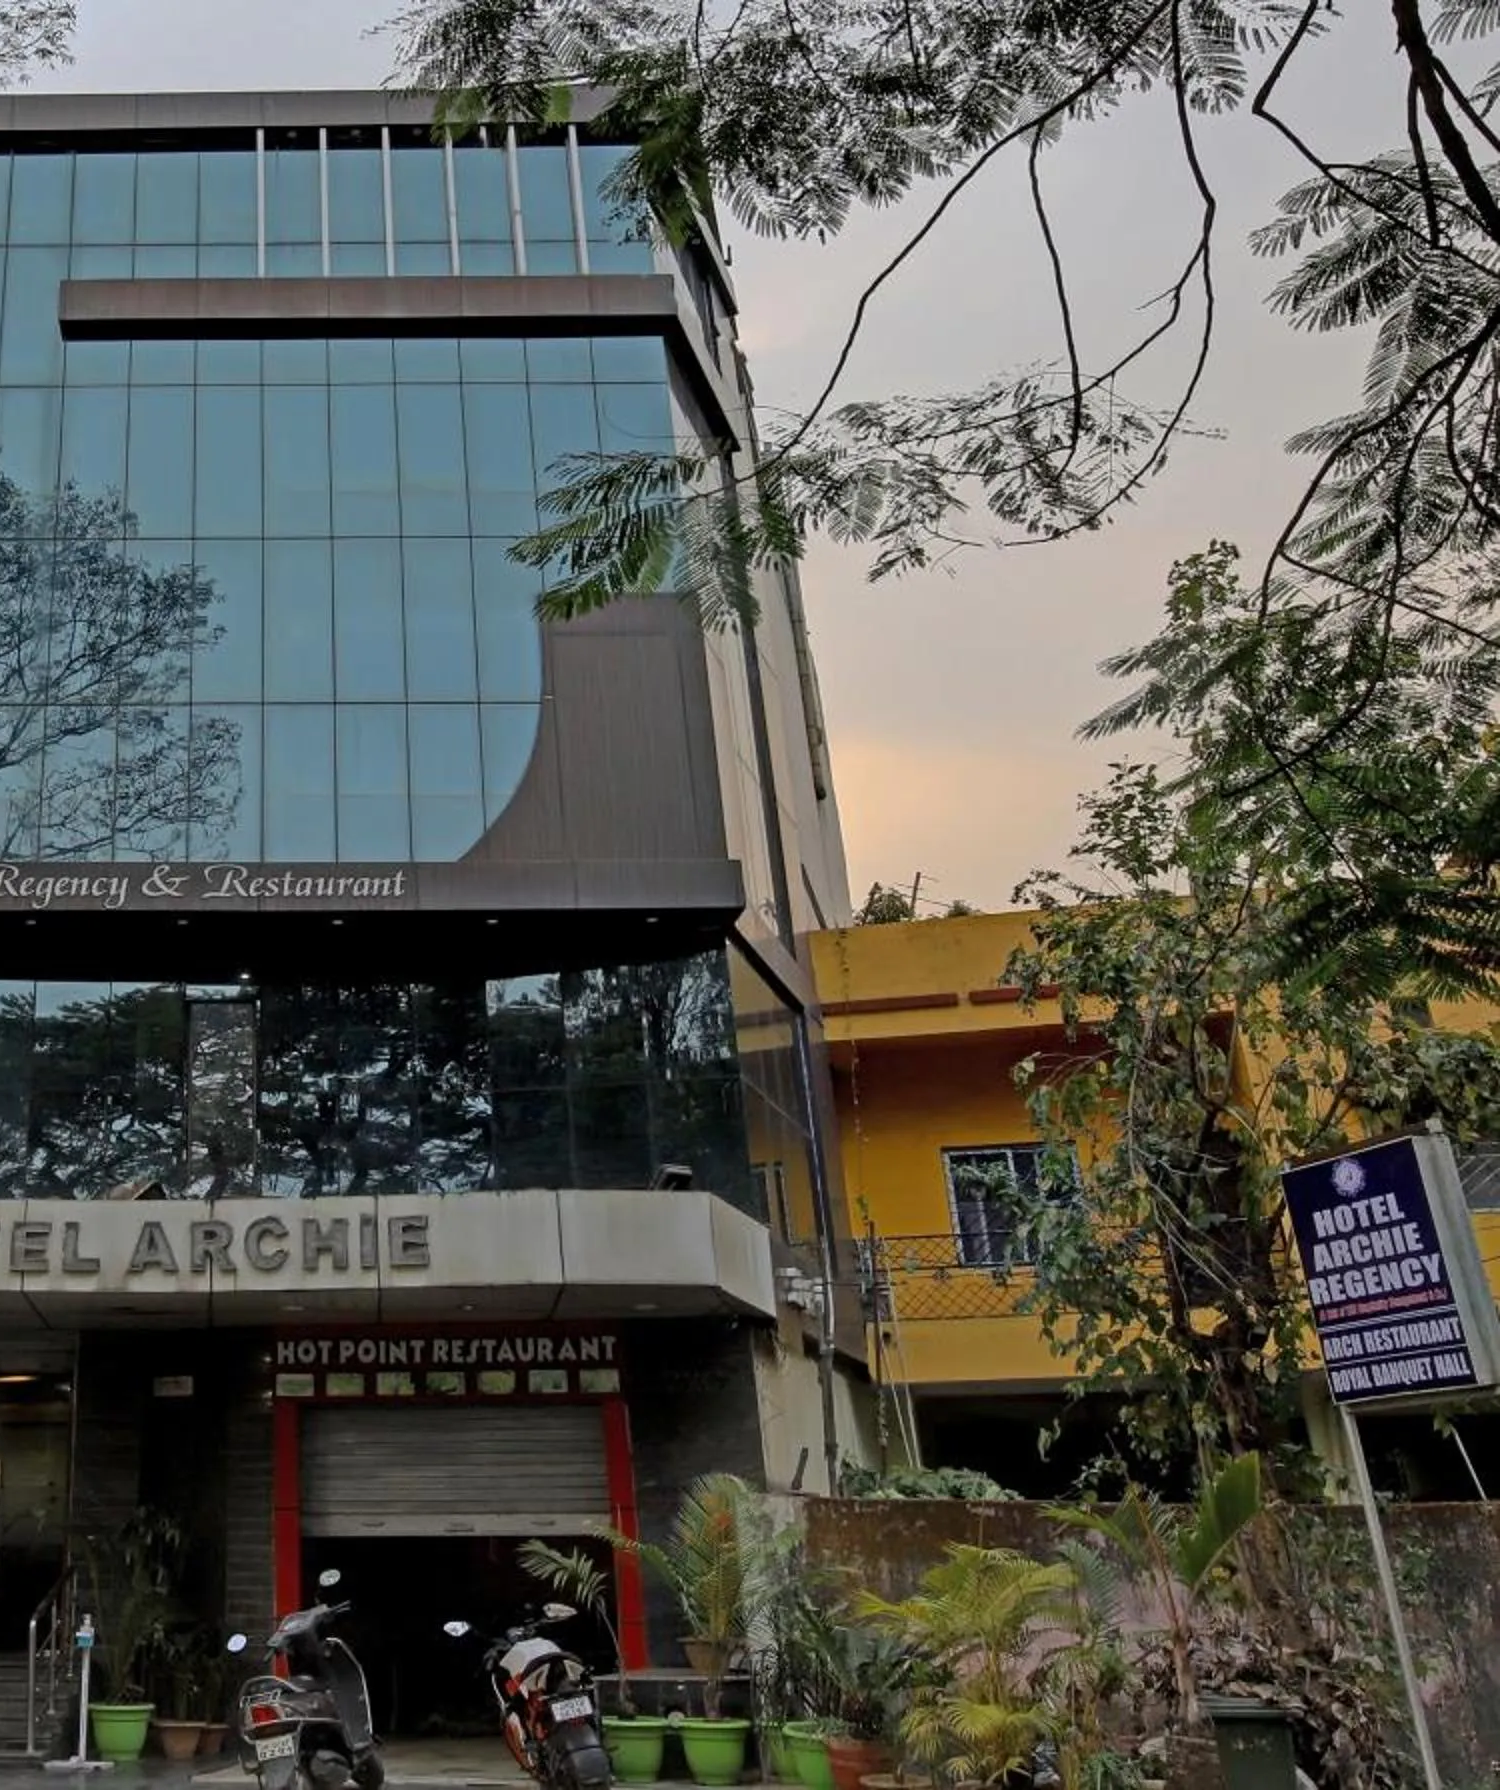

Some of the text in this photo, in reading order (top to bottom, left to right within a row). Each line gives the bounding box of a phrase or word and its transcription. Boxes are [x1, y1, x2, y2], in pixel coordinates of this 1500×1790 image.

[141, 864, 190, 899] &
[201, 864, 406, 899] Restaurant
[1312, 1192, 1405, 1238] HOTEL
[127, 1214, 431, 1272] ARCHIE
[1313, 1222, 1424, 1273] ARCHIE
[1308, 1253, 1444, 1305] REGENCY
[277, 1336, 617, 1365] HOT POINT RESTAURANT
[1323, 1317, 1463, 1361] ARCH RESTAURANT
[1331, 1351, 1471, 1393] ROYAL BANQUET HALL
